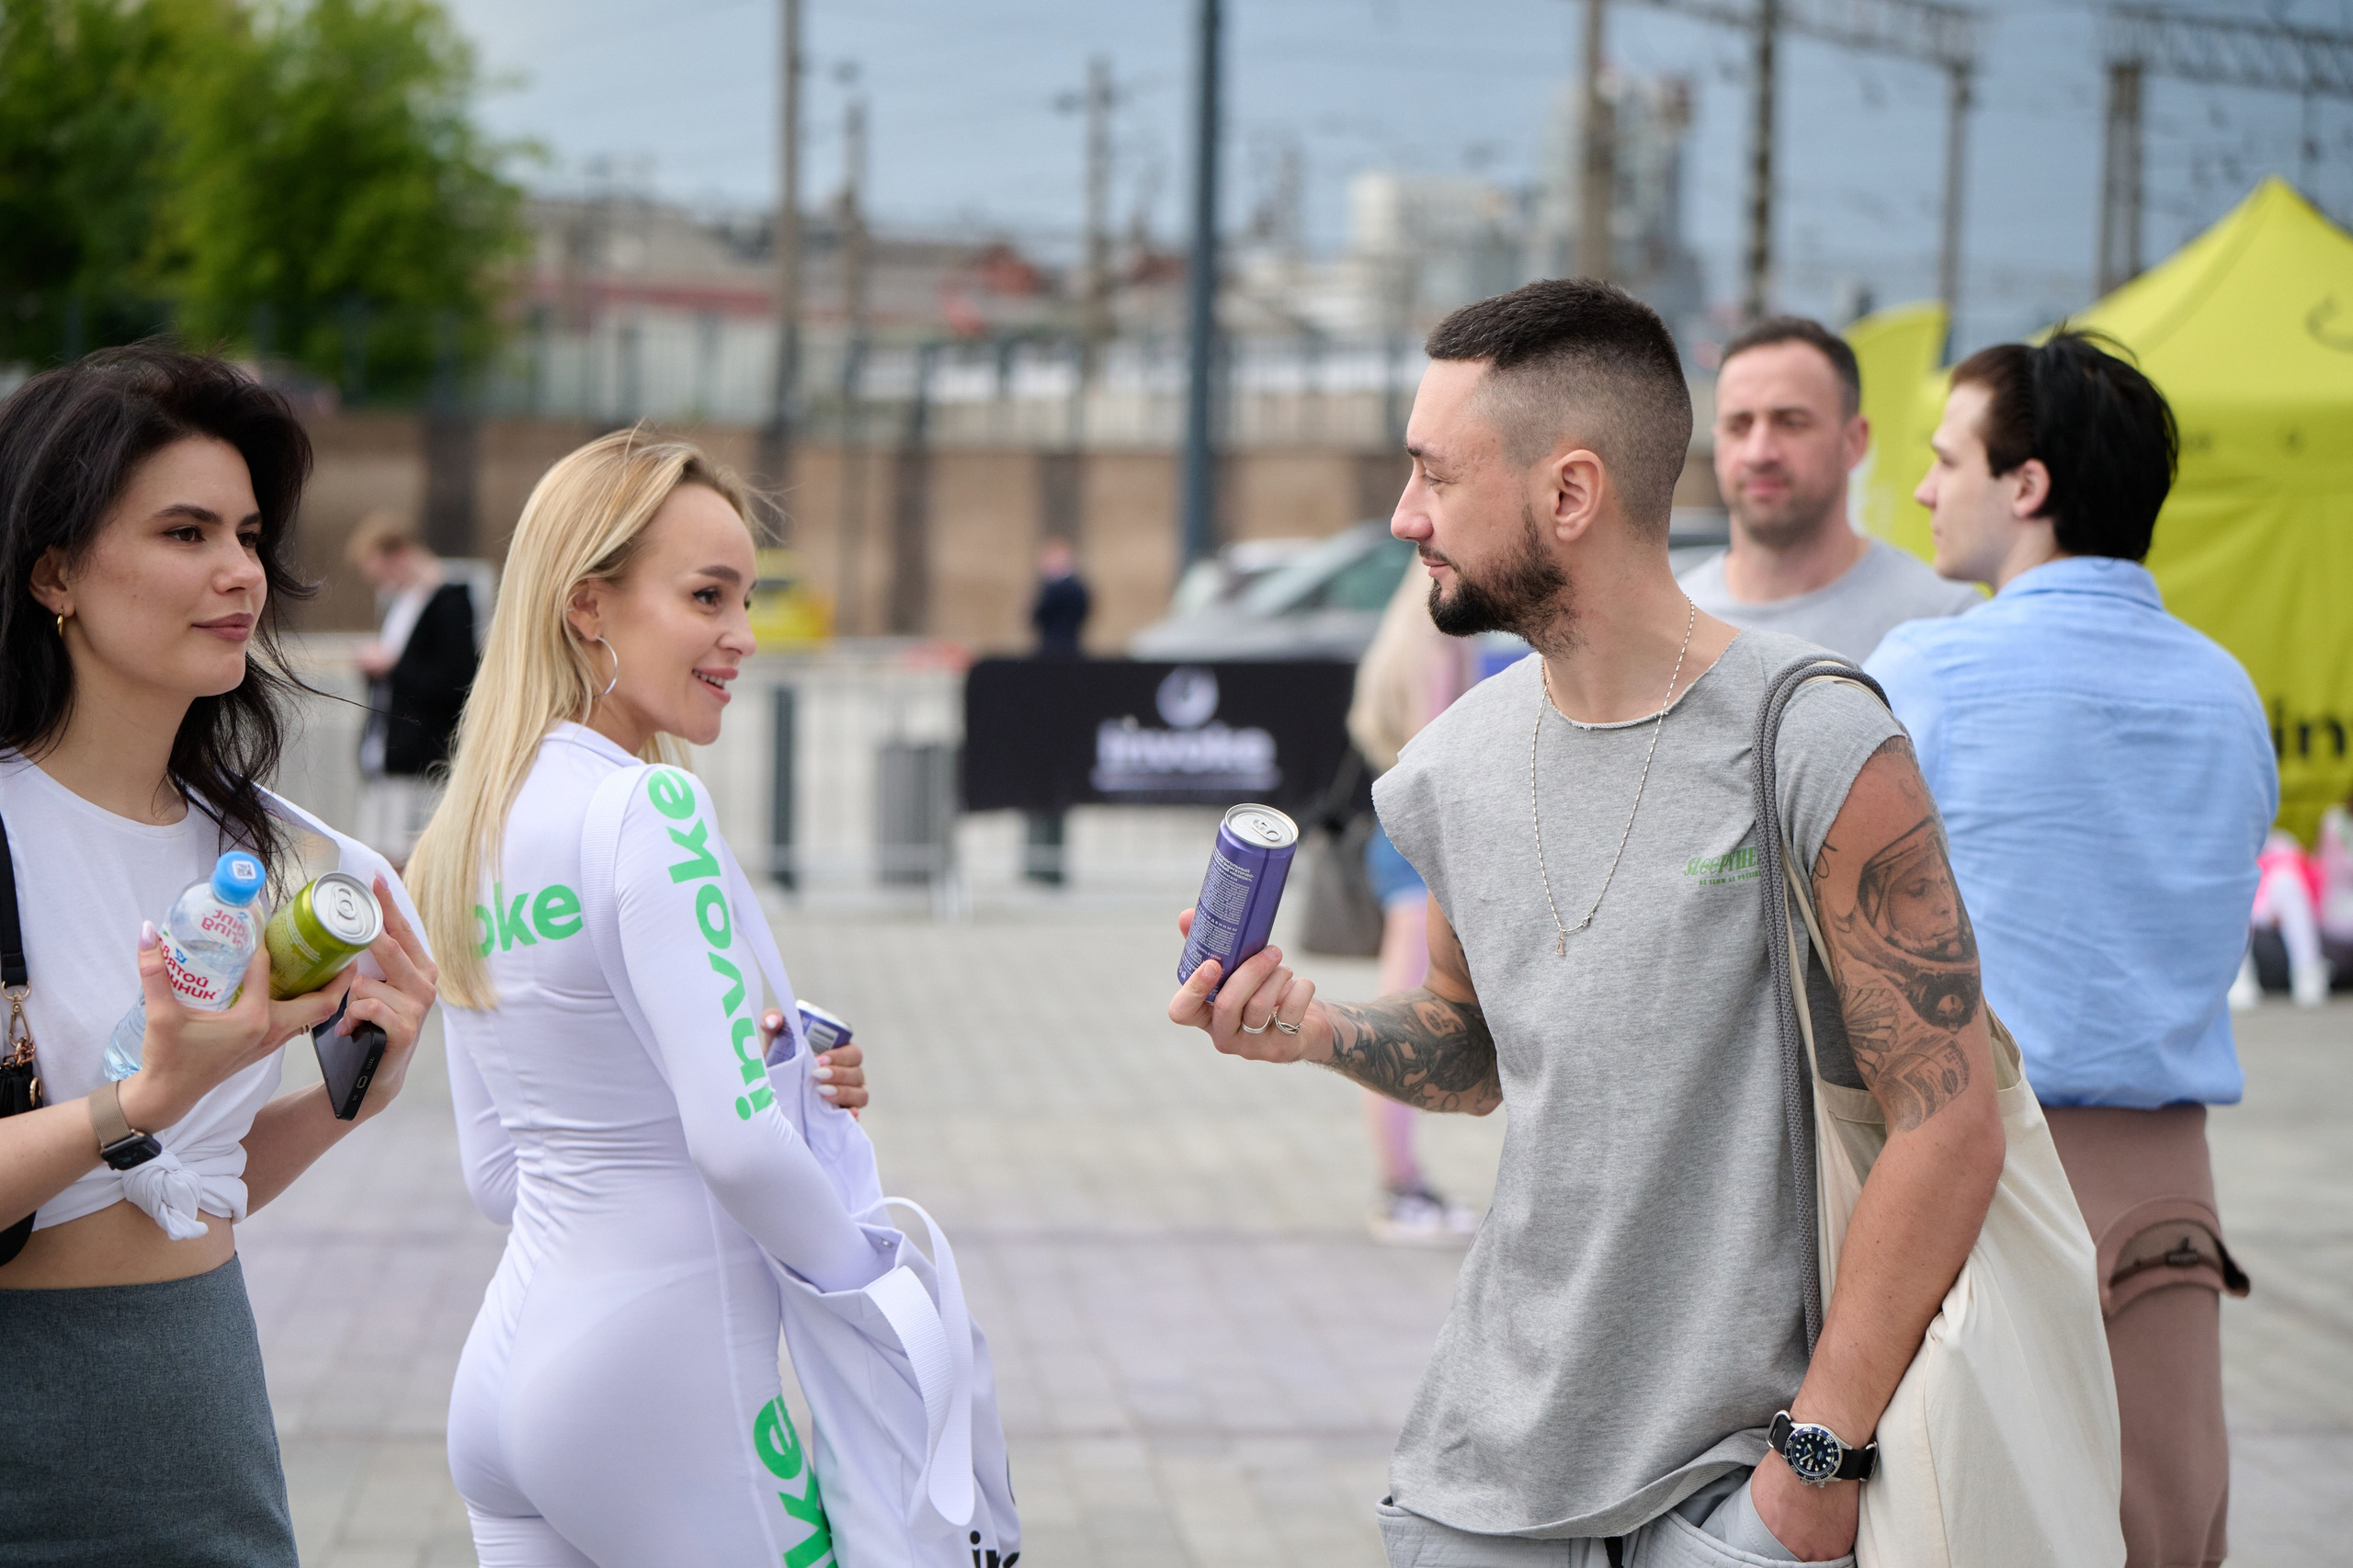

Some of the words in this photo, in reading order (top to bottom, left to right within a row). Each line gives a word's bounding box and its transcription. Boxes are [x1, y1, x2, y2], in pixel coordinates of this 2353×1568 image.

[2273, 696, 2347, 759] in
[168, 973, 218, 1001] ЧНИК
[646, 767, 775, 1121] invoke
[753, 1392, 838, 1568] ke
